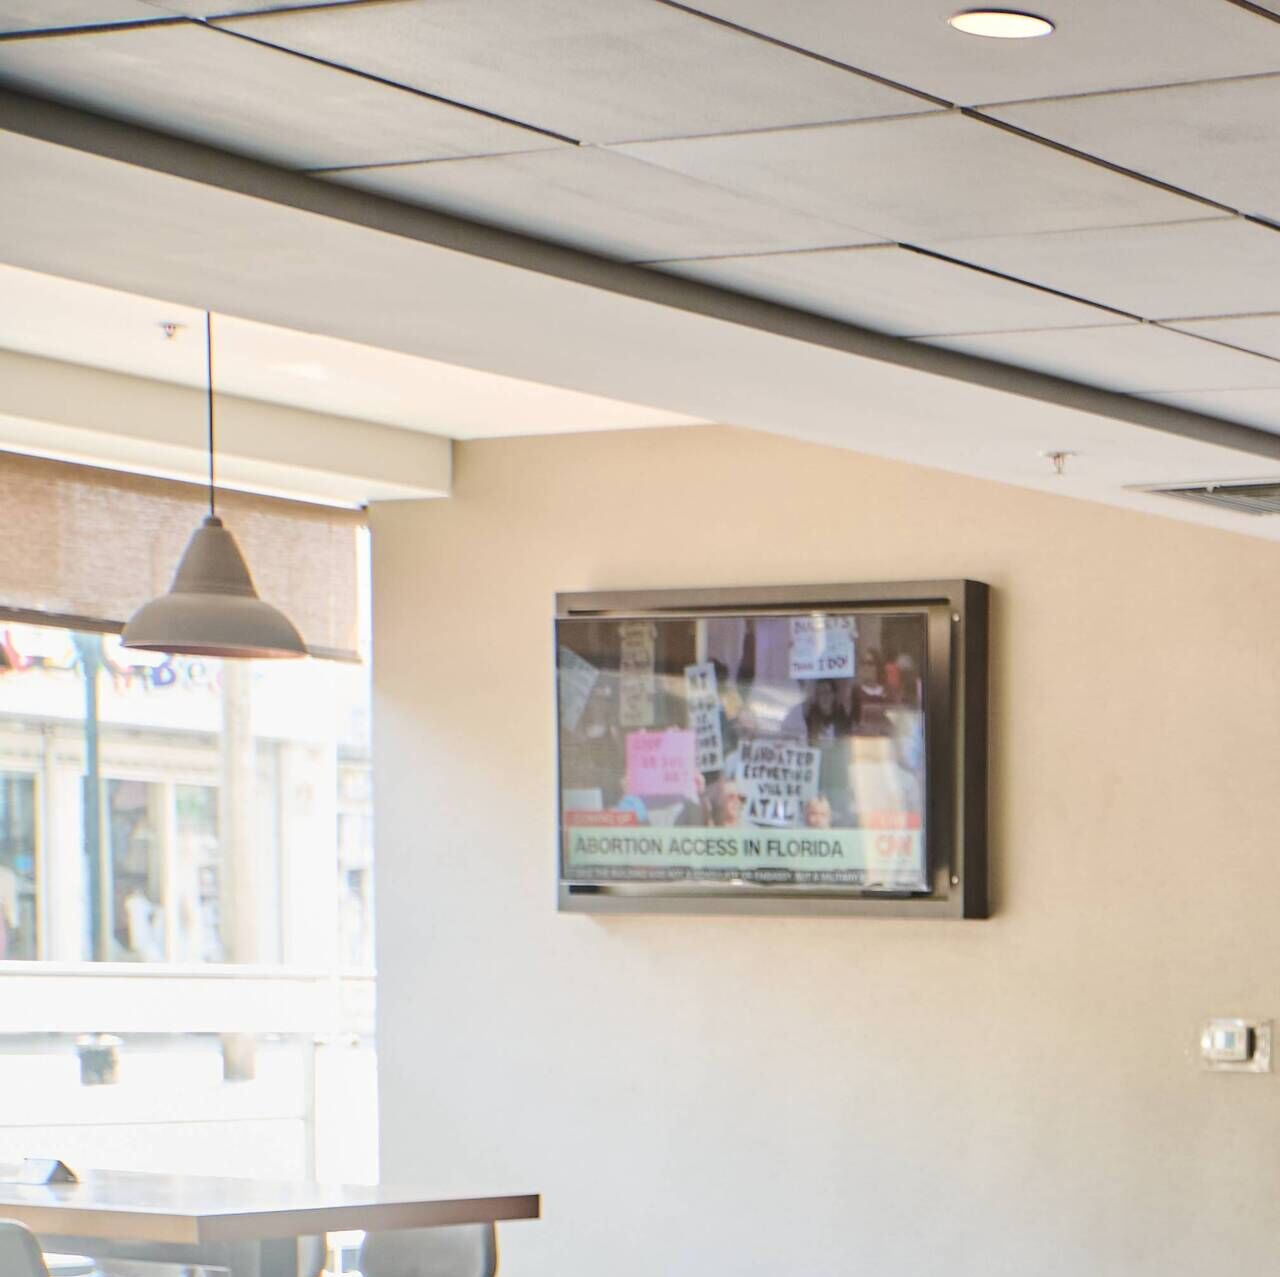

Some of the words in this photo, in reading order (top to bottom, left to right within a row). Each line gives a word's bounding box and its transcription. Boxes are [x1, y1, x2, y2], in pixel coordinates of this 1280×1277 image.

[575, 837, 663, 855] ABORTION
[669, 838, 738, 856] ACCESS
[743, 839, 761, 856] IN
[767, 839, 844, 858] FLORIDA
